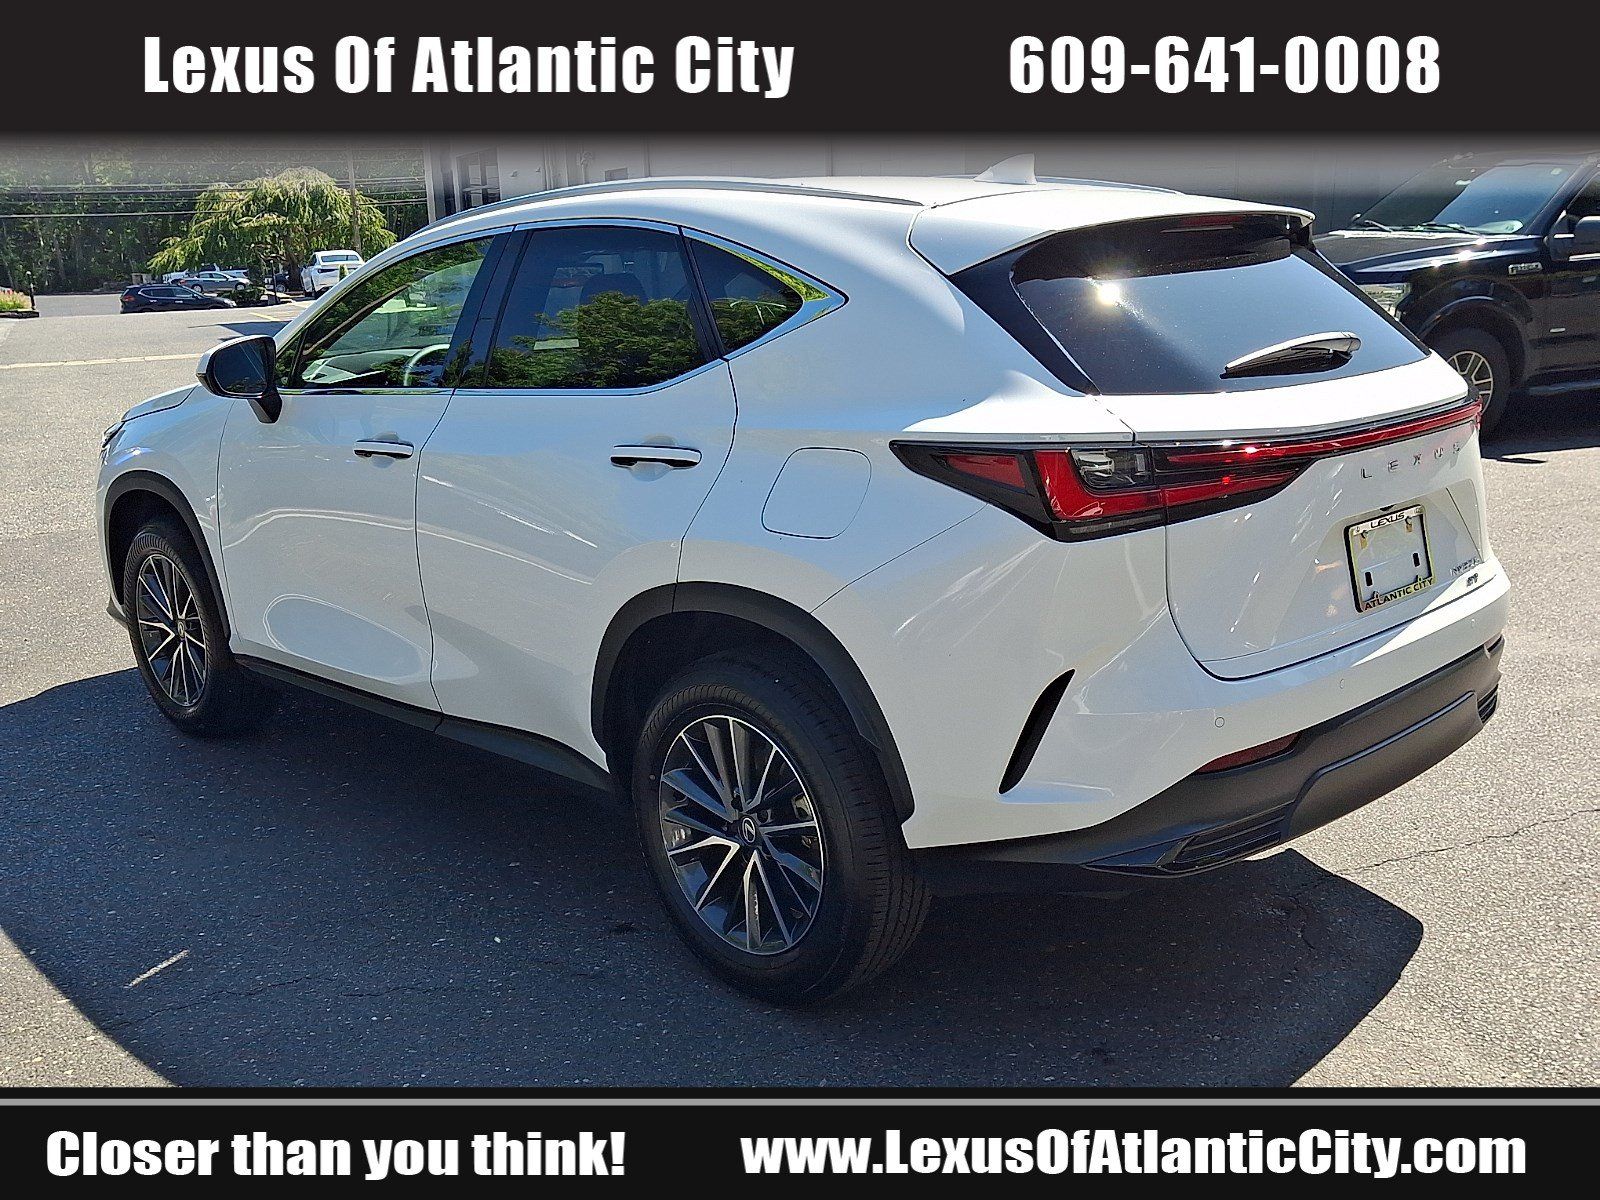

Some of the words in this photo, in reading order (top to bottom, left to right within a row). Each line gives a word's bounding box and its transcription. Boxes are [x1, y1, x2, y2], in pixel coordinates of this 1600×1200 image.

[1360, 441, 1461, 480] LEXUS
[1370, 512, 1406, 529] LEXUS
[1364, 586, 1412, 611] ATLANTIC
[1413, 577, 1434, 592] CITY
